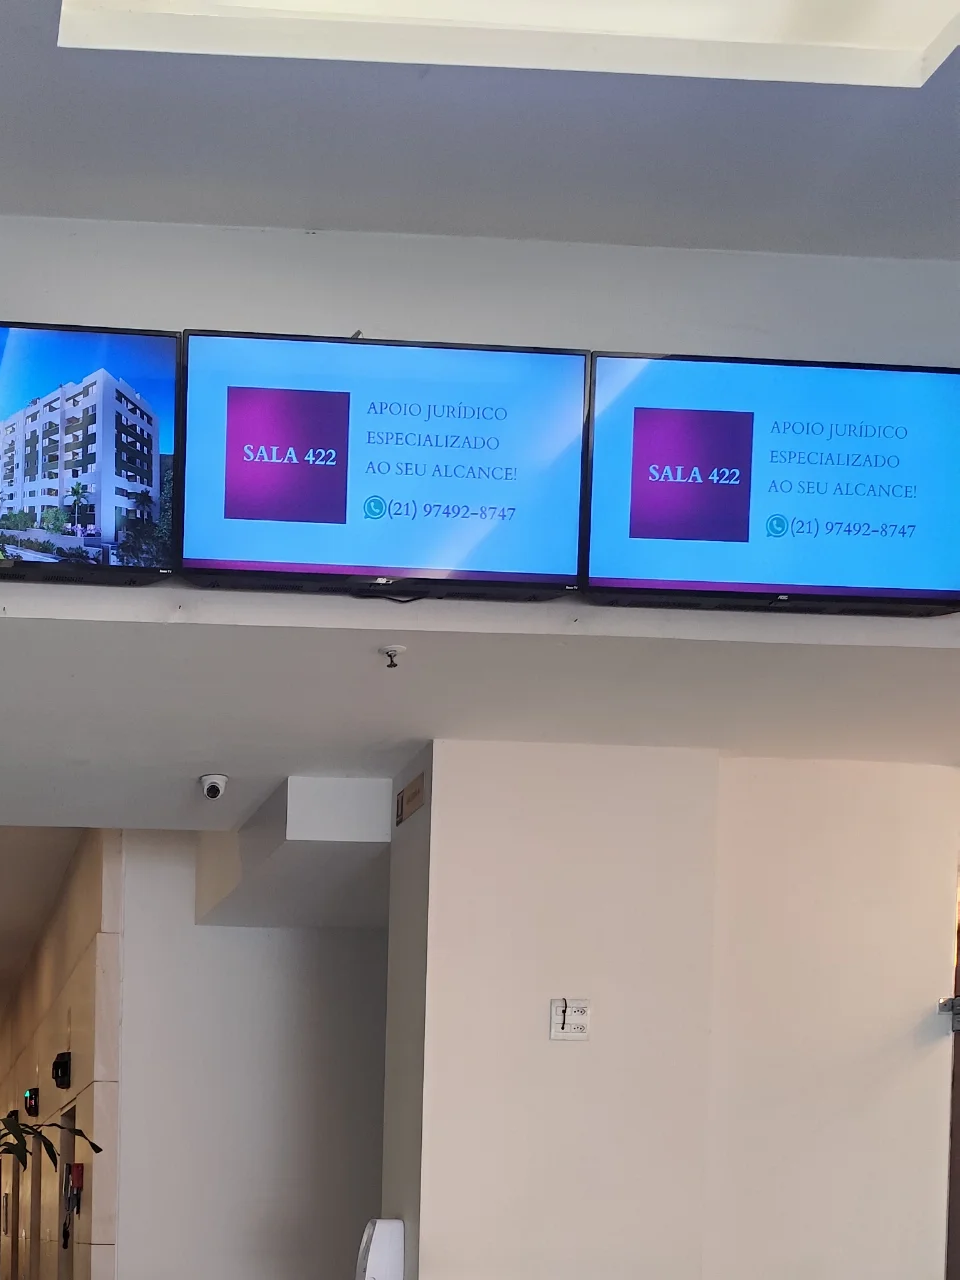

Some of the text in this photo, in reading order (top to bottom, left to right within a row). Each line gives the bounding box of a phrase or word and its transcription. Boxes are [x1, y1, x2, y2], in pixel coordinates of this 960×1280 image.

[367, 401, 508, 422] APOIO JURÍDICO
[366, 431, 500, 450] ESPECIALIZADO
[770, 421, 908, 441] APOIO JURÍDICO
[243, 444, 336, 465] SALA 422
[770, 450, 900, 468] ESPECIALIZADO
[365, 461, 518, 481] AO SEU ALCANCE!
[648, 464, 740, 485] SALA 422
[768, 480, 917, 499] AO SEU ALCANCE!
[388, 499, 516, 521] (21) 97492-8747
[791, 516, 917, 538] (21) 97492-8747
